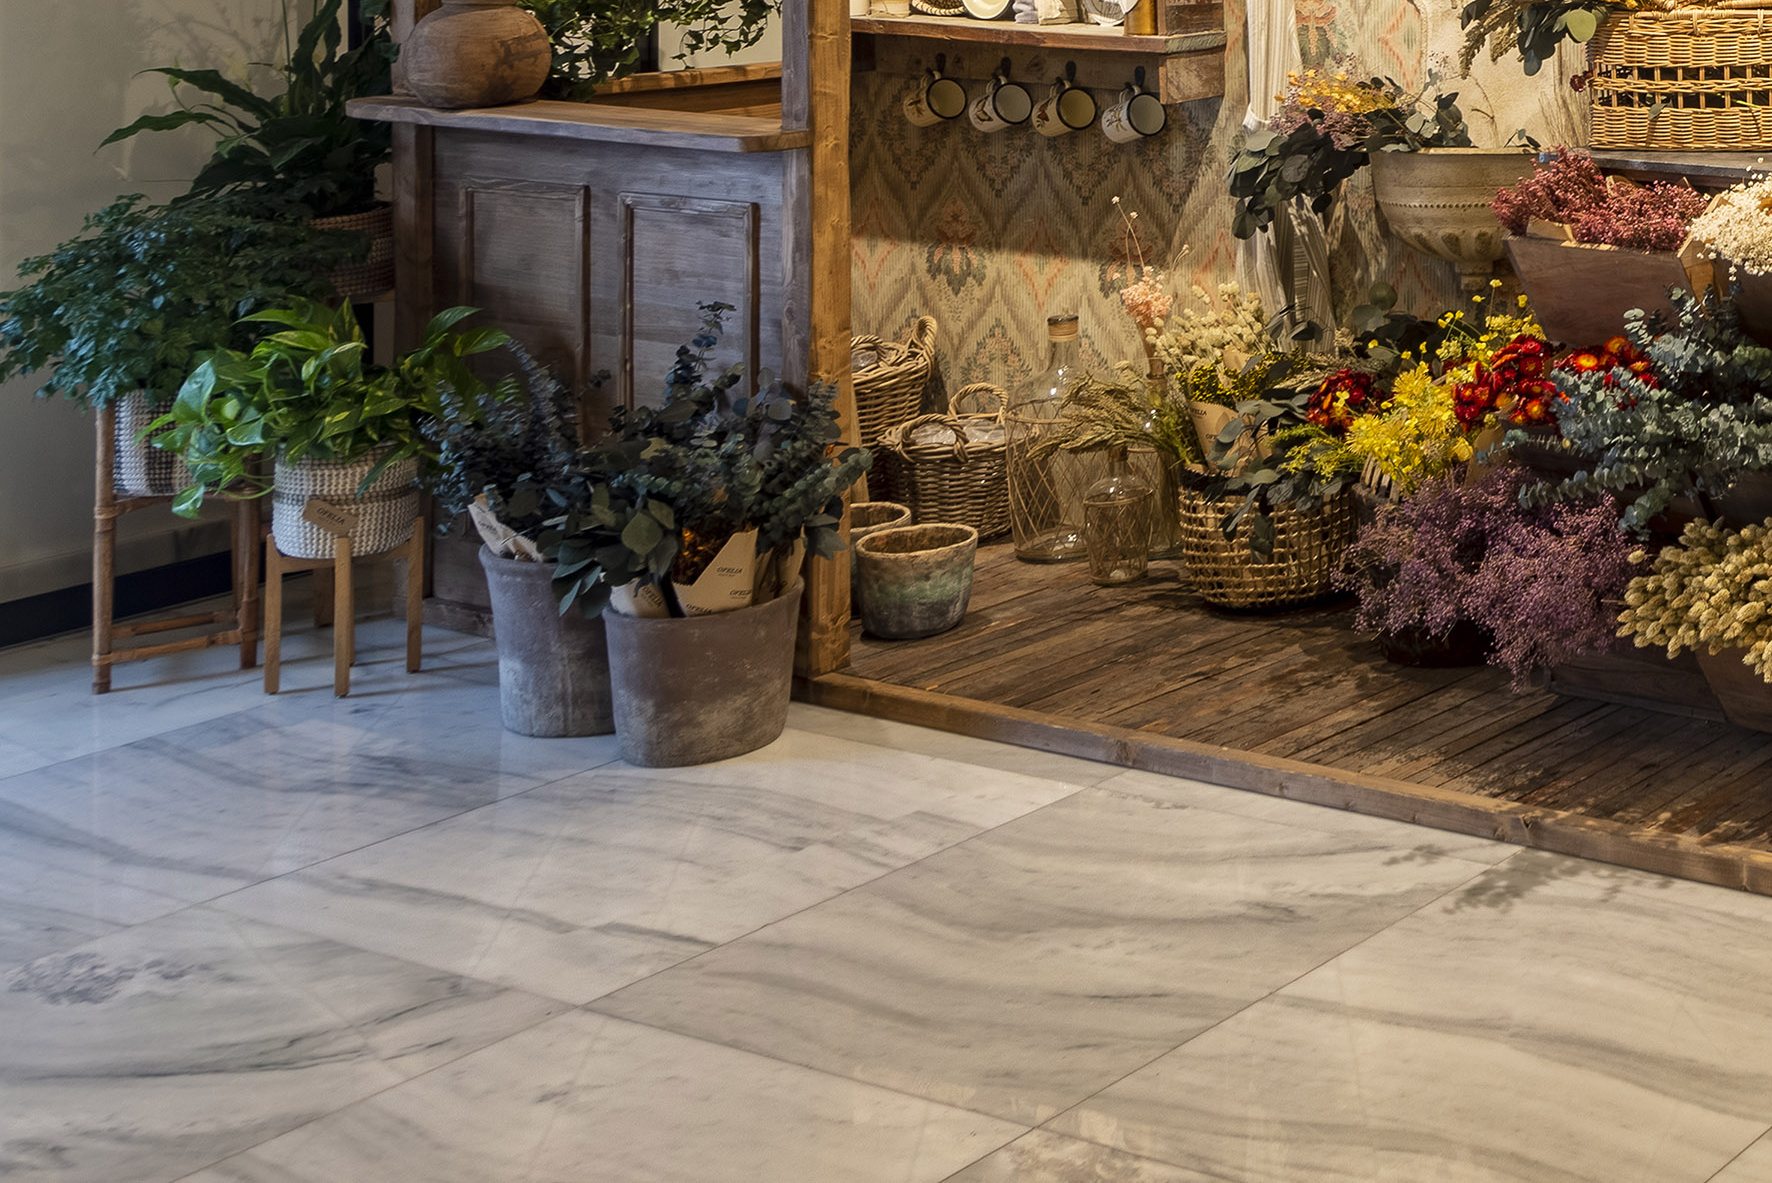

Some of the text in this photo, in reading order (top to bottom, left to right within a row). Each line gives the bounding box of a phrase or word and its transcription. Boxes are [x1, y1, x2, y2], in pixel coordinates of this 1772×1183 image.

[316, 507, 345, 525] OFELIA
[717, 566, 743, 574] OFELIA
[642, 586, 663, 608] OFELIA
[686, 603, 713, 614] OFELIA
